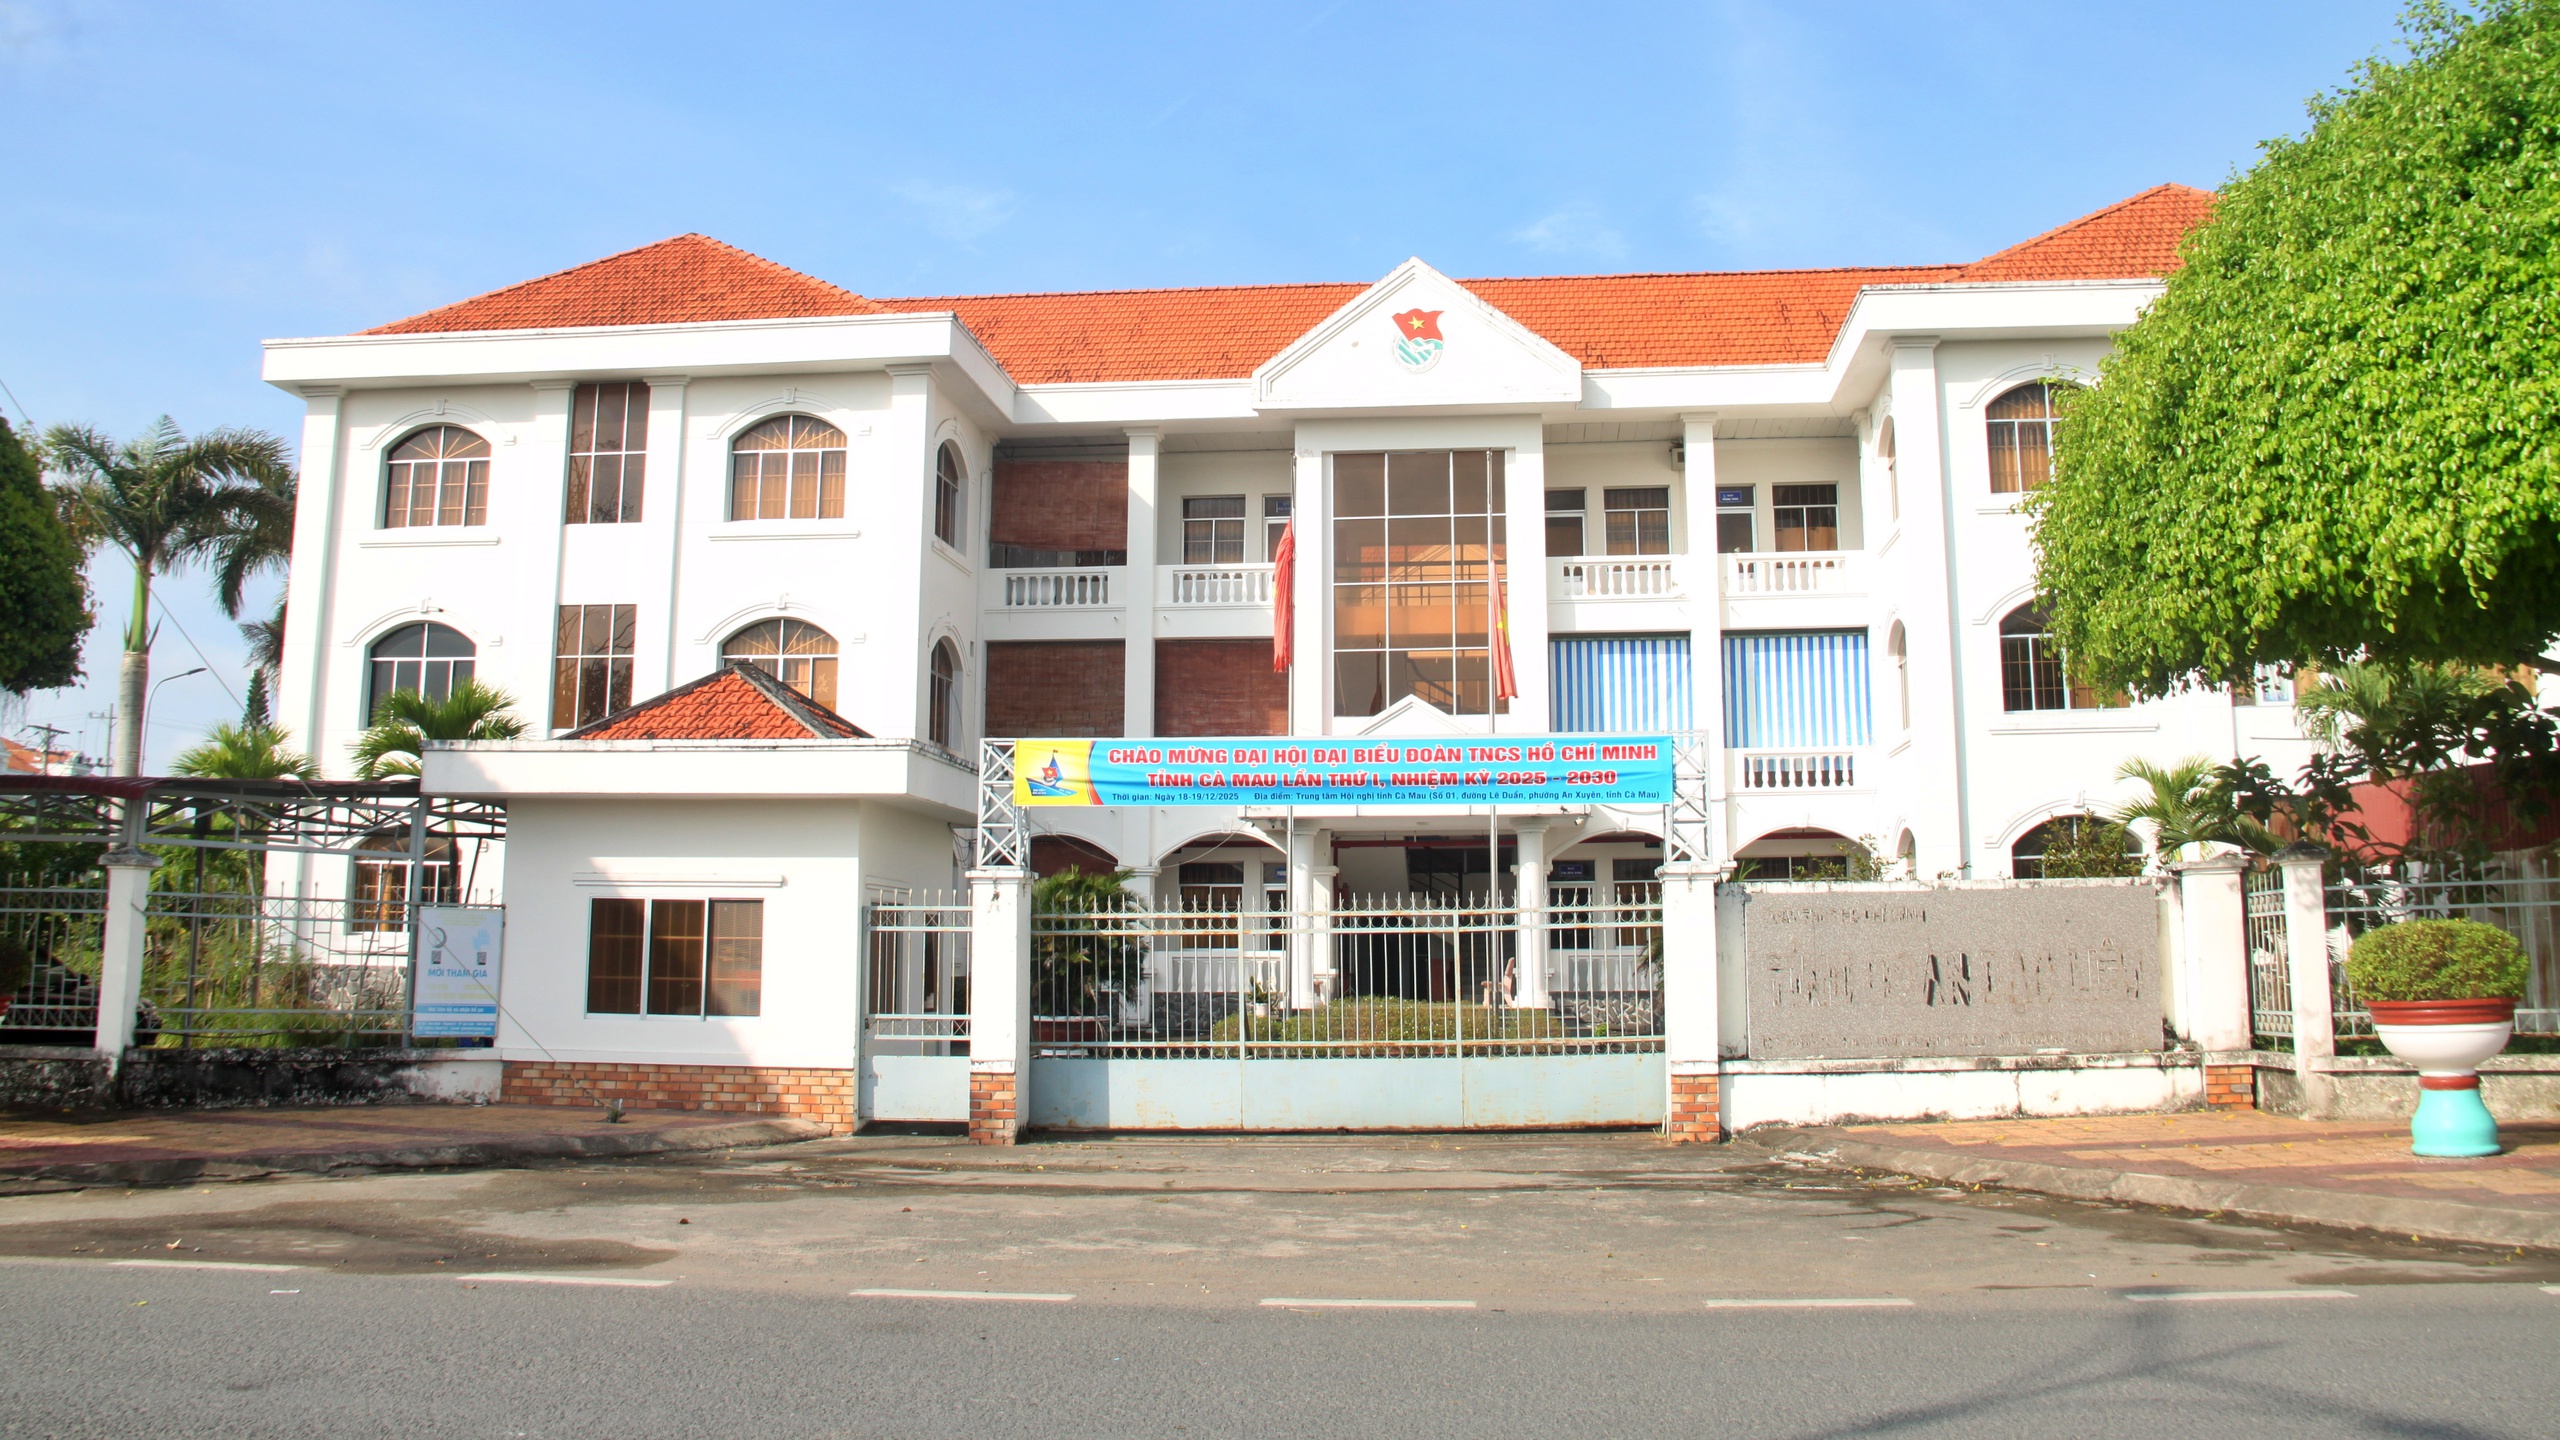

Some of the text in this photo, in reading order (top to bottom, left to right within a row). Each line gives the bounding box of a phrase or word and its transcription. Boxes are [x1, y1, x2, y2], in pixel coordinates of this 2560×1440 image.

[1109, 742, 1657, 767] CHÀO MỪNG ĐẠI HỘI ĐẠI BIỂU ĐOÀN TNCS HỒ CHÍ MINH
[1147, 769, 1193, 787] TỈNH
[1198, 771, 1226, 787] CÀ
[1232, 773, 1277, 787] MAU
[1282, 769, 1322, 787] LẦN
[1328, 771, 1368, 787] THỨ
[1372, 774, 1385, 788] I,
[1391, 770, 1459, 789] NHIỆM
[1464, 770, 1491, 785] KỲ
[1496, 772, 1546, 785] 2025
[1566, 770, 1617, 785] 2030
[1112, 792, 1239, 802] Thời gian: Ngày 18-19/12/2025
[1254, 792, 1268, 801] Địa
[1270, 791, 1293, 800] điểm:
[1296, 792, 1320, 801] Trung
[1322, 791, 1338, 800] tâm
[1340, 791, 1354, 801] Hội
[1356, 791, 1375, 801] nghị
[1395, 791, 1406, 800] Cà
[1408, 791, 1427, 800] Mau
[1429, 790, 1443, 800] (Số
[1445, 791, 1459, 800] 01,
[1461, 791, 1487, 801] đường
[1489, 791, 1500, 799] Lê
[1528, 791, 1560, 801] phường
[1562, 791, 1573, 799] An
[1575, 791, 1604, 800] Xuyên,
[1624, 790, 1636, 799] Cà
[1638, 790, 1660, 800] Mau)
[446, 968, 471, 978] THAM
[473, 969, 488, 978] GIA
